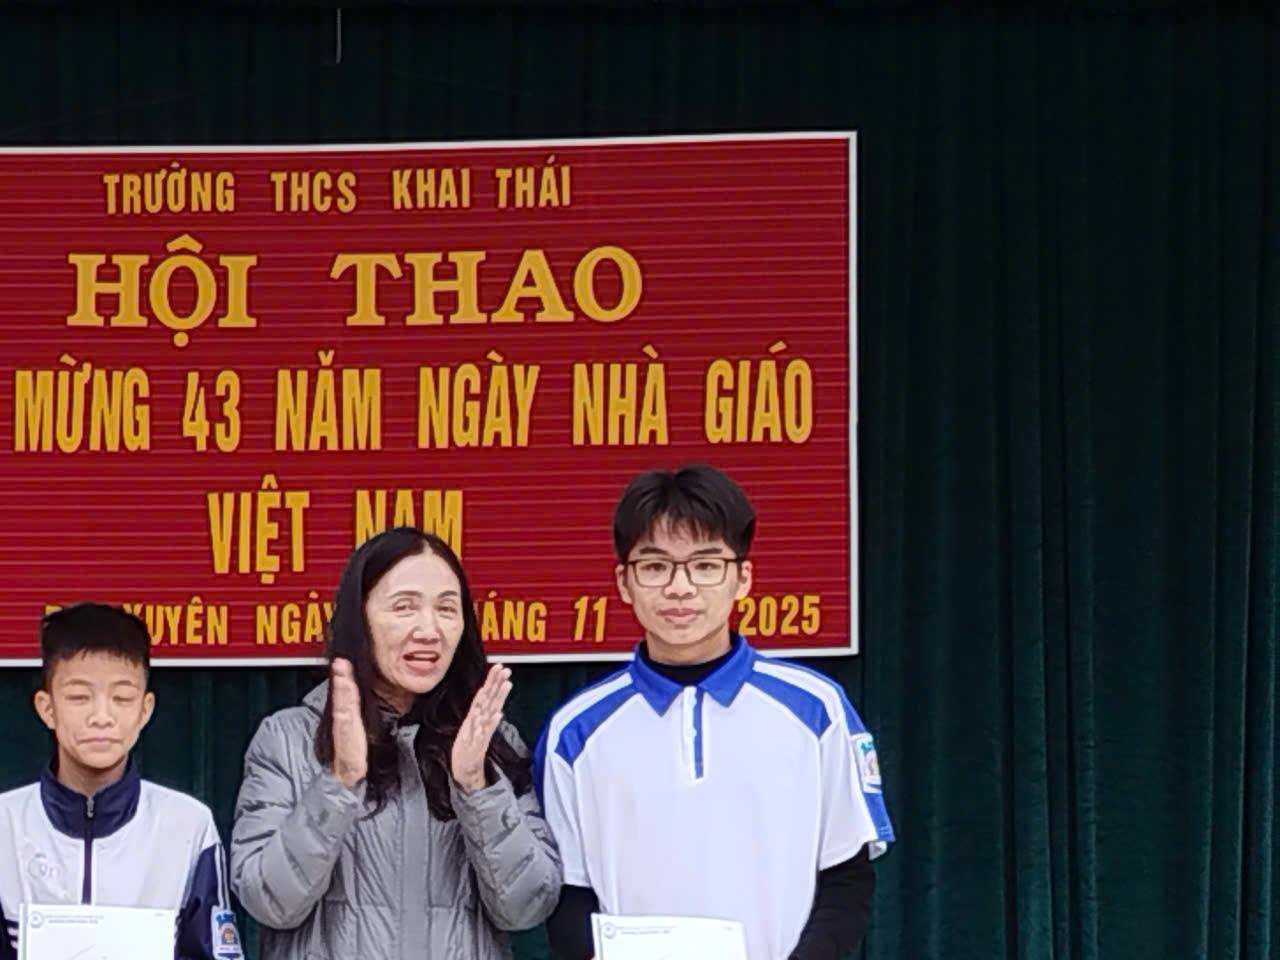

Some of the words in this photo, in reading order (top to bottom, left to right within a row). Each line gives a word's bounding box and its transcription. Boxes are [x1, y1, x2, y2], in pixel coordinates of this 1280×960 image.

[103, 160, 235, 214] TRƯỜNG
[271, 169, 357, 213] THCS
[393, 167, 471, 210] KHAI
[495, 154, 571, 209] THÁI
[66, 233, 257, 348] HỘI
[329, 245, 643, 326] THAO
[14, 353, 150, 453] MỪNG
[182, 369, 241, 452] 43
[275, 349, 382, 451] NĂM
[418, 350, 540, 449] NGÀY
[572, 344, 669, 446] NHÀ
[704, 340, 813, 444] GIÁO
[207, 474, 310, 584] VIỆT
[574, 595, 608, 643] 11
[738, 594, 820, 637] 2025
